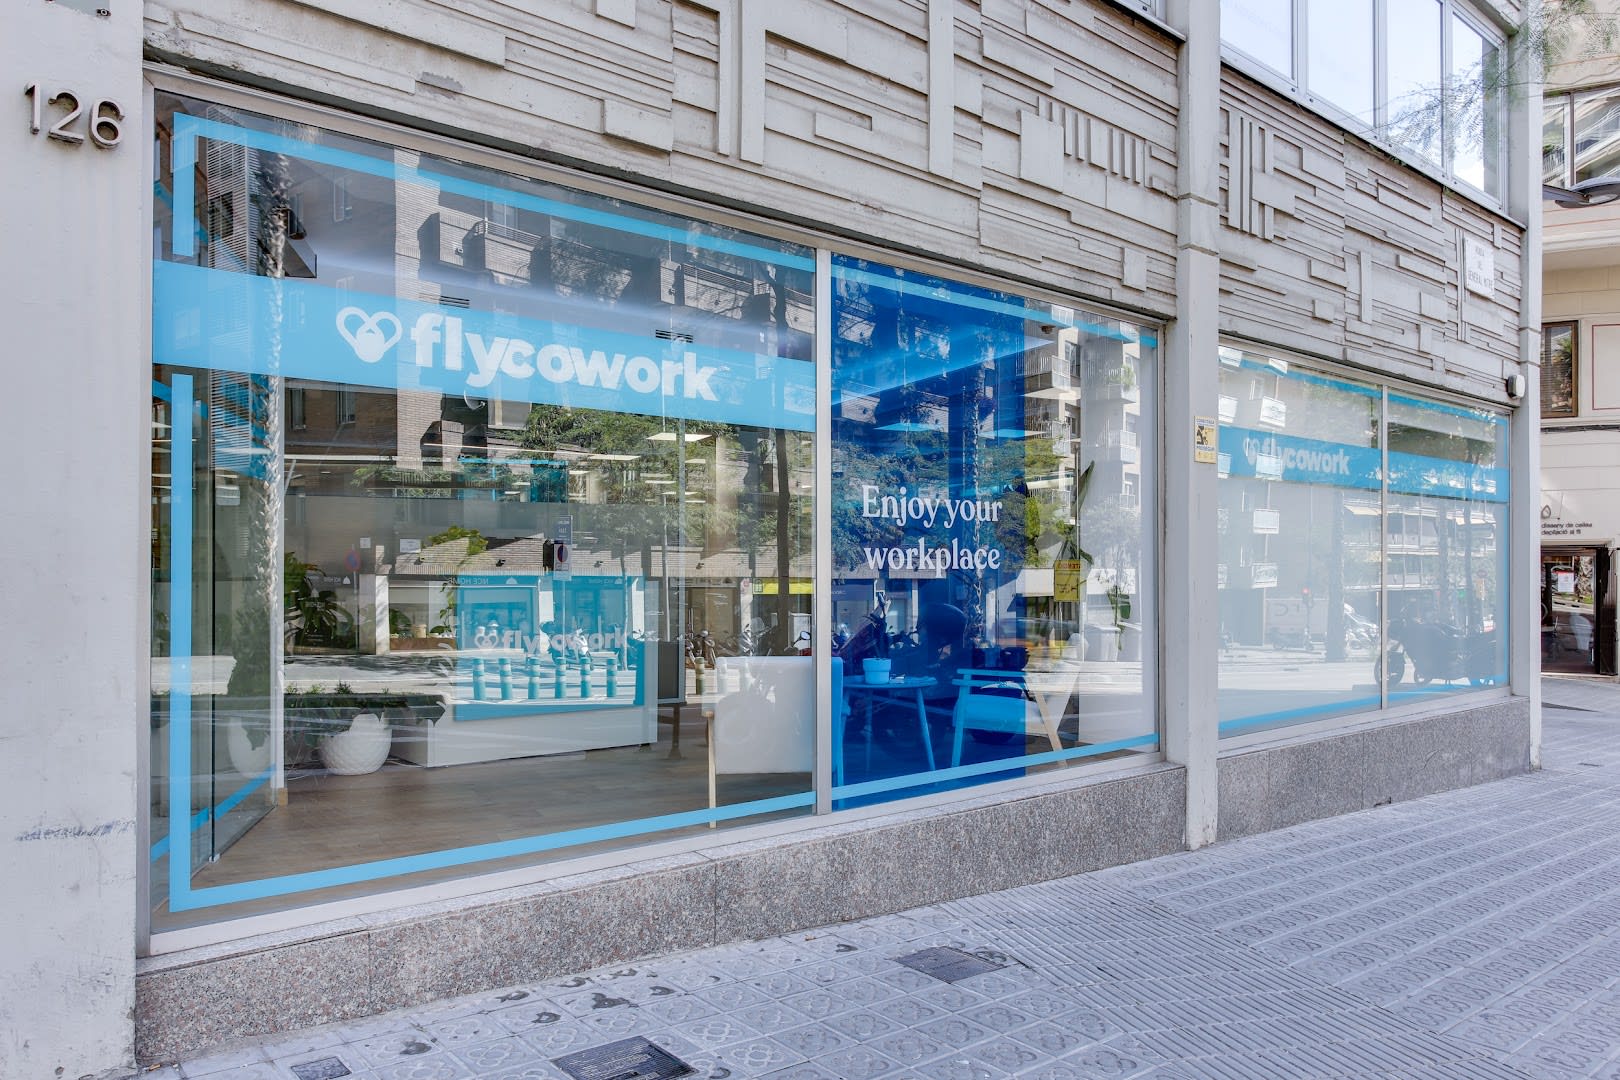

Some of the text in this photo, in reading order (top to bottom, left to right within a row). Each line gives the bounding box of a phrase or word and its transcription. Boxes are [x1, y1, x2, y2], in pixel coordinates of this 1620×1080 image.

[24, 81, 124, 149] 126
[411, 312, 719, 401] flycowork
[862, 484, 1003, 529] Enjoy your
[863, 536, 1001, 579] workplace
